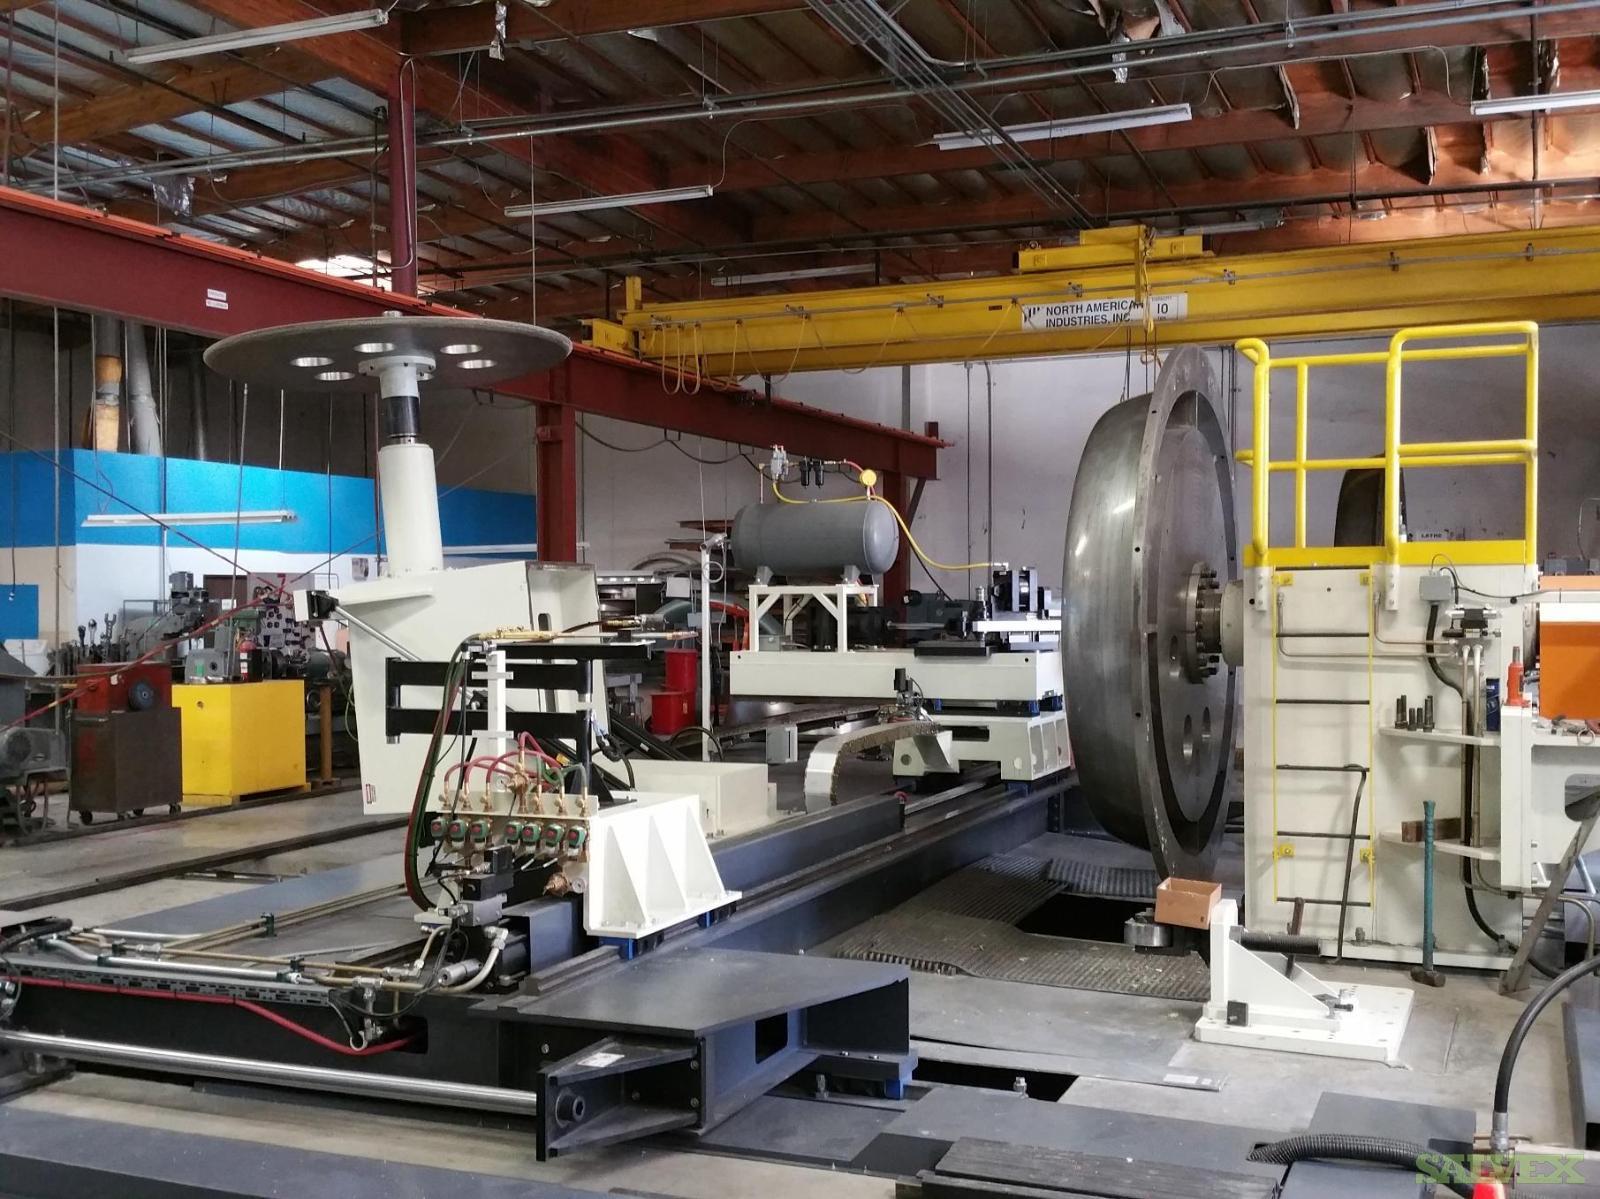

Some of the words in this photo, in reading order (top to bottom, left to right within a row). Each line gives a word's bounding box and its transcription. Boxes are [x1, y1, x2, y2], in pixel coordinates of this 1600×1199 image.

[1046, 304, 1083, 316] NORTH
[1157, 303, 1169, 314] 10
[1046, 314, 1111, 328] INDUSTRIES,
